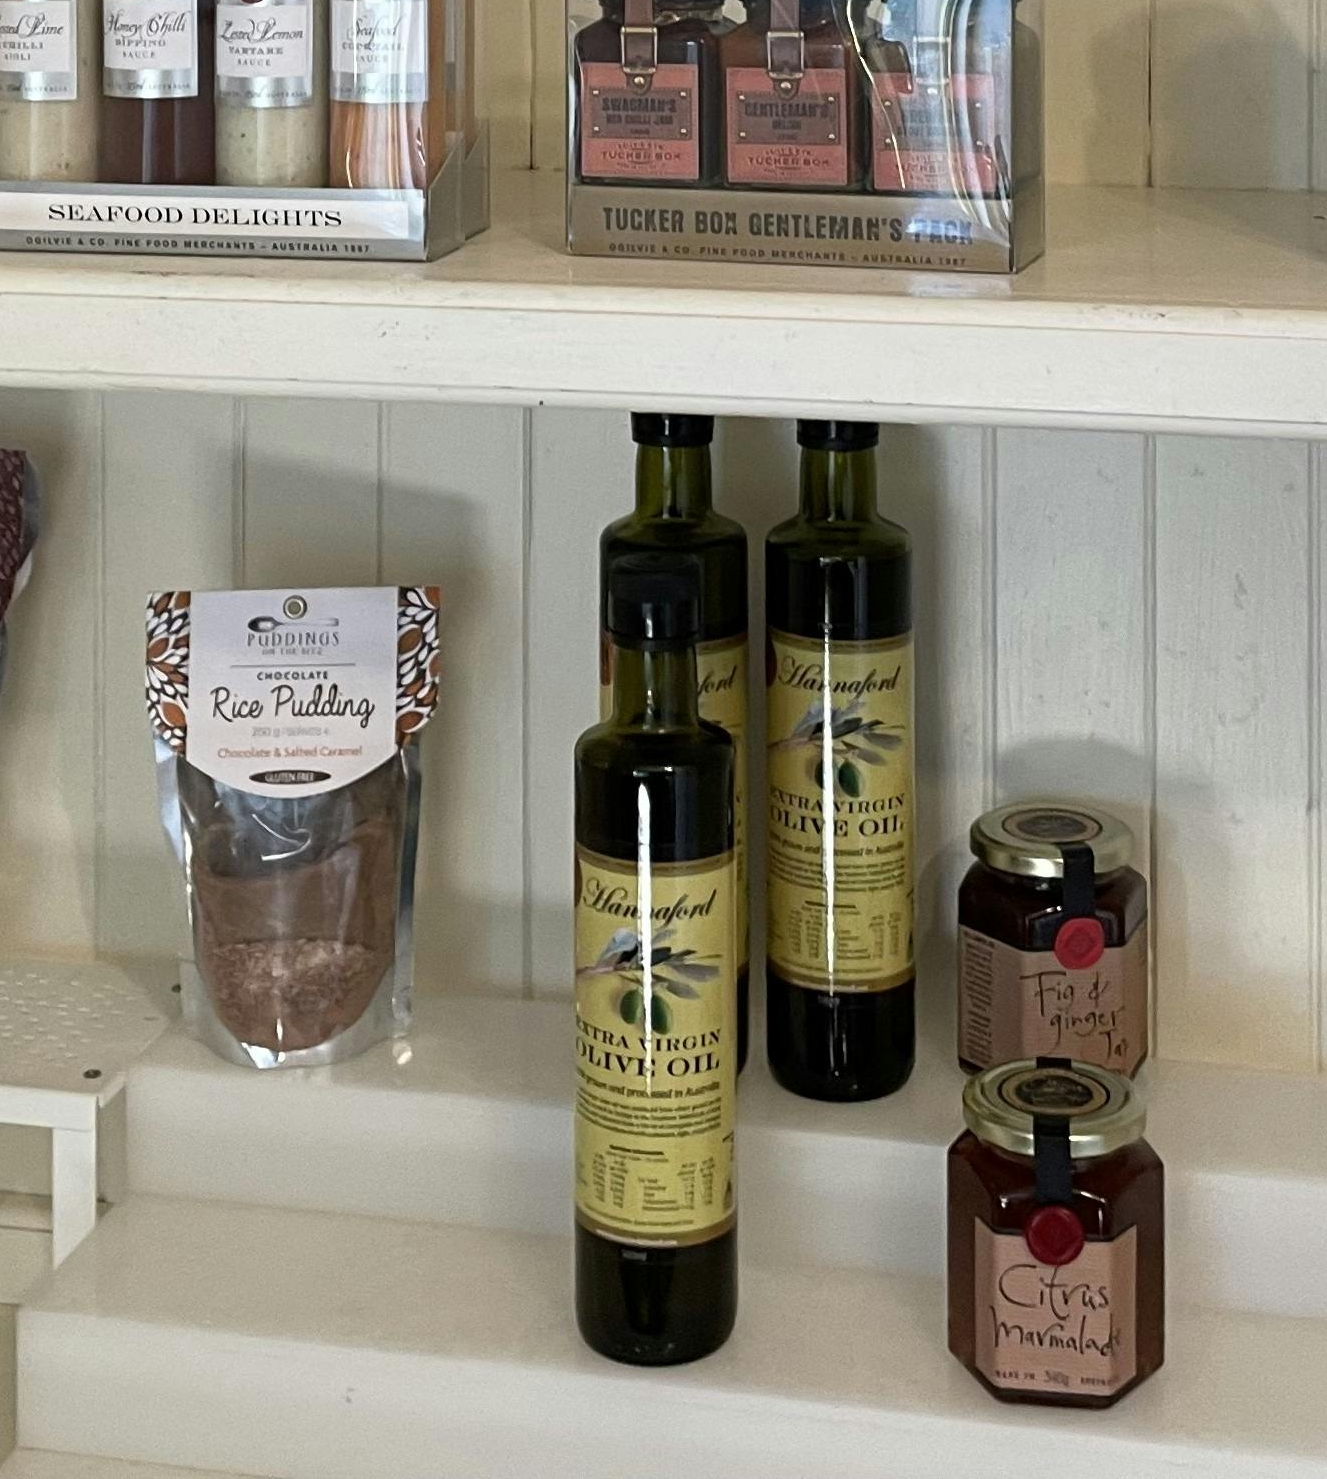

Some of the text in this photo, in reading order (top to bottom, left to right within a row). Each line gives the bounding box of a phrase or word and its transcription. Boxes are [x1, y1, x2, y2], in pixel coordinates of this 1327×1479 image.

[48, 204, 342, 227] SEAFOOD DELIGHTS
[603, 207, 902, 243] TUCKER BOX GENTLEMAN'S
[26, 236, 72, 246] OGILVIE
[77, 238, 85, 246] &
[113, 239, 140, 247] FINE
[146, 240, 179, 248] FOOD
[184, 240, 255, 250] MERCHANTS
[272, 243, 339, 252] AUSTRALIA
[247, 632, 340, 647] PUDDINGS
[256, 671, 328, 680] CHOCOLATE
[210, 683, 375, 728] Rice Pudding
[217, 745, 363, 758] Chocolate & Salted Caramel
[666, 1051, 720, 1077] OIL
[998, 1264, 1109, 1321] Citrus
